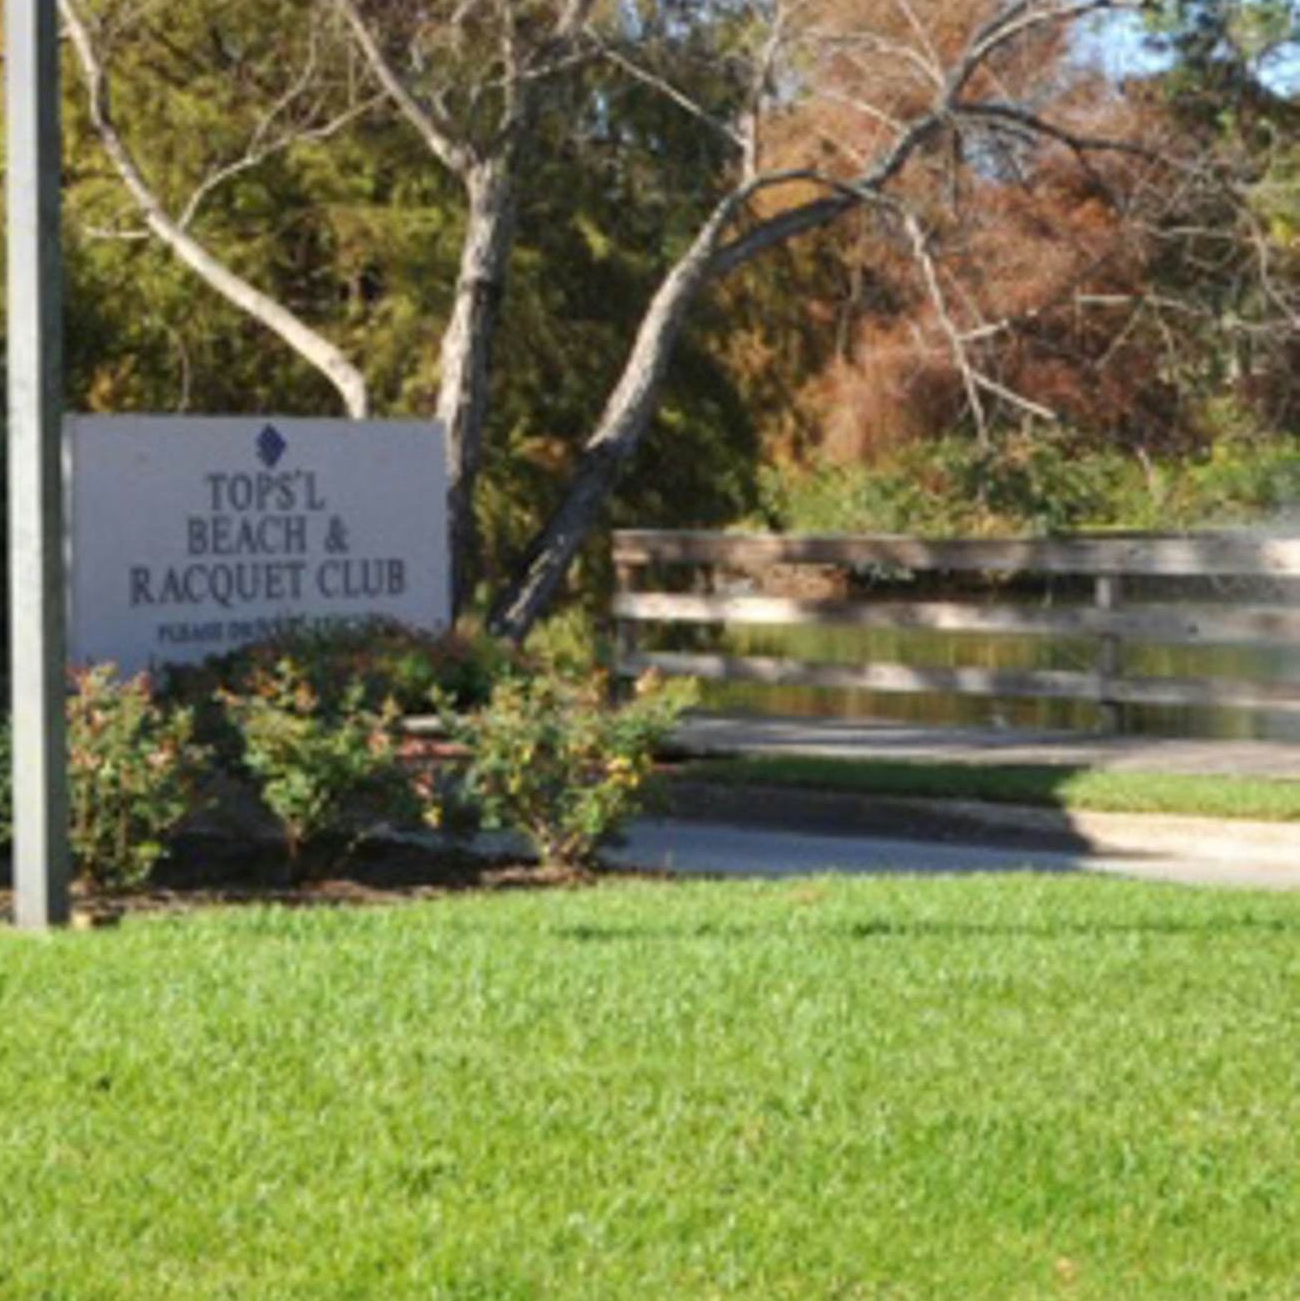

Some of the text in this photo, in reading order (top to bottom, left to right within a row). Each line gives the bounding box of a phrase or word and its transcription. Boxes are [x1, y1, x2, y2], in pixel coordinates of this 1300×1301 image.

[207, 468, 326, 511] TOPS'L
[187, 514, 350, 556] BEACH &
[129, 558, 407, 608] RACQUET CLUB
